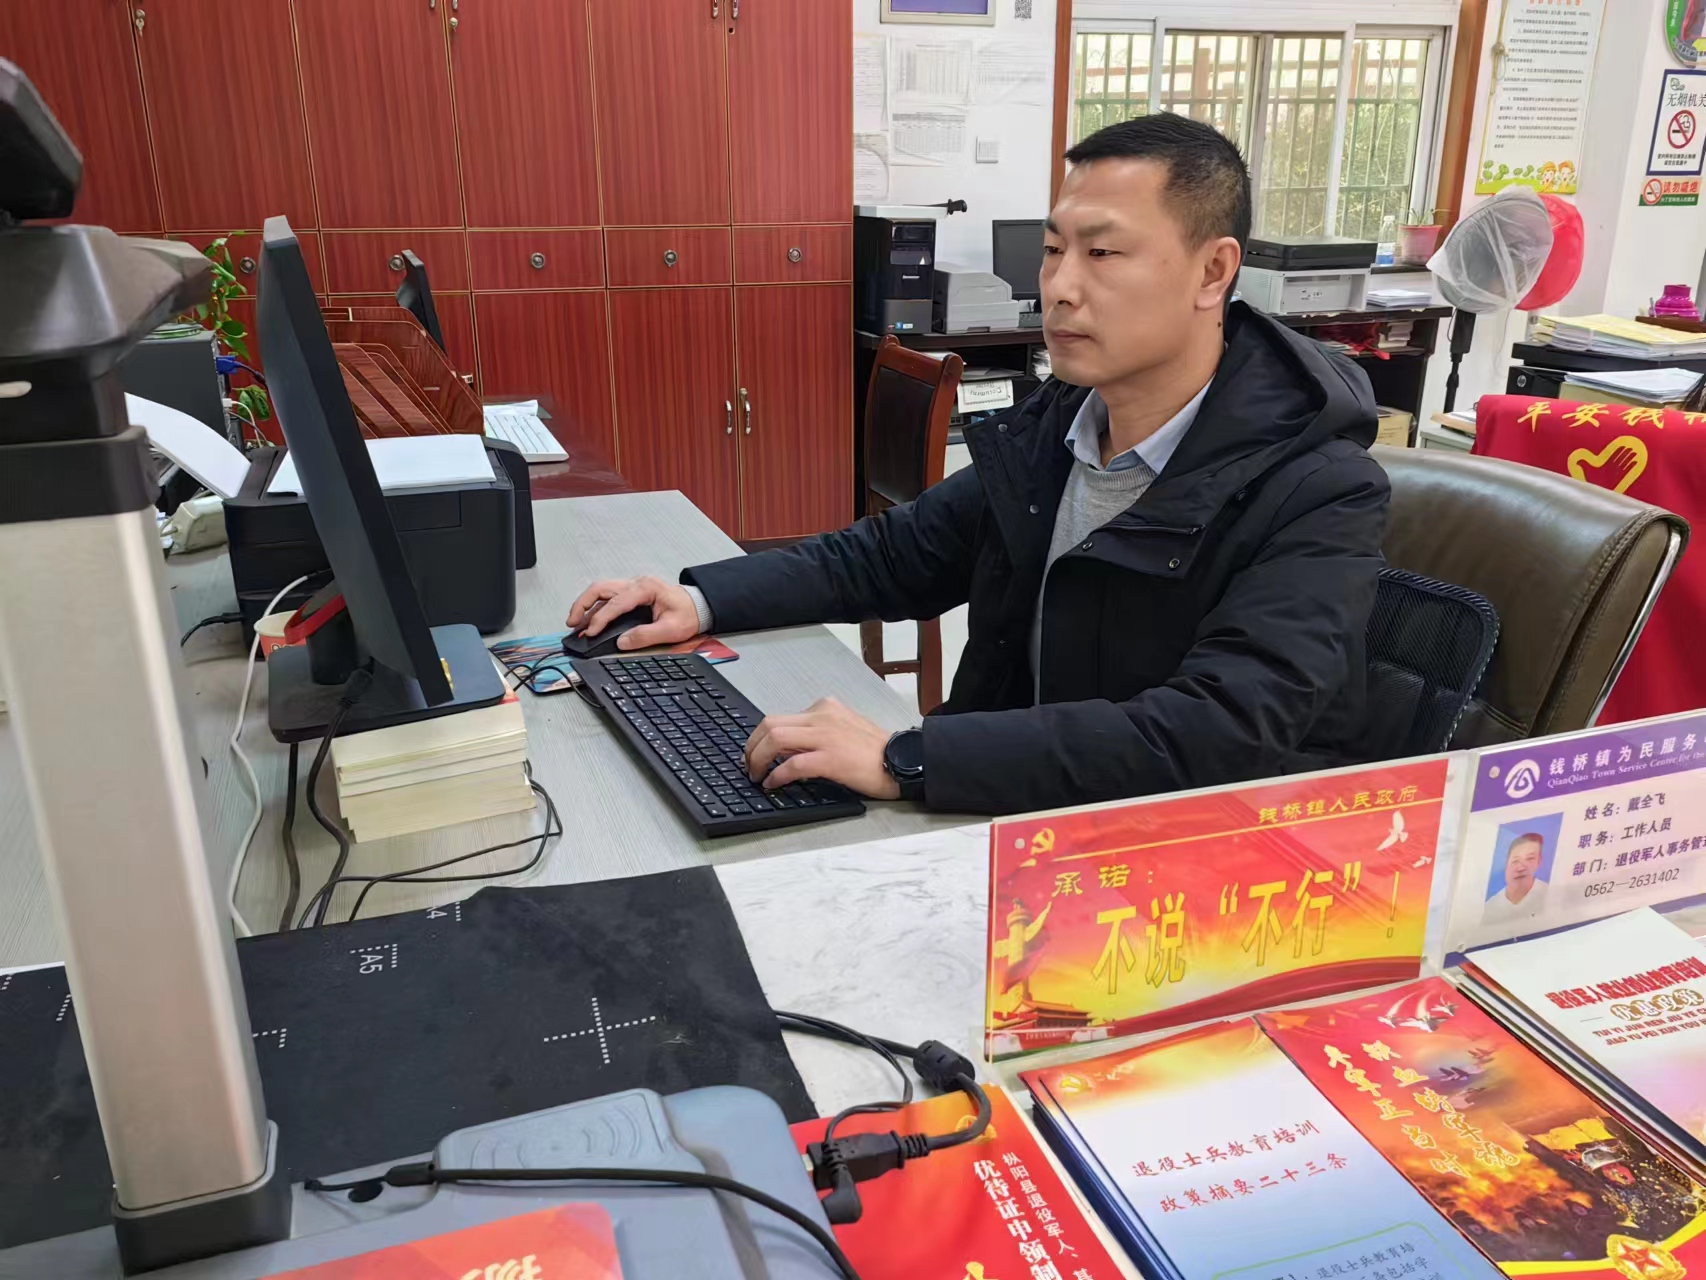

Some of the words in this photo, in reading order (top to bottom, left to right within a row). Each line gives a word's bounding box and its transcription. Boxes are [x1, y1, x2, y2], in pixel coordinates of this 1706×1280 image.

[1548, 732, 1706, 776] 钱桥镇为民服务
[1547, 773, 1589, 788] QianQiao
[1592, 768, 1616, 779] Town
[1618, 762, 1648, 773] Service
[1257, 784, 1419, 825] 钱桥镇人民政府
[1577, 817, 1672, 849] 职务：工作人员
[359, 954, 384, 975] A5
[1611, 988, 1704, 1021] 优惠政策
[1131, 1118, 1321, 1179] 退役士兵教育培训
[1159, 1150, 1350, 1214] 政策摘要二十三条
